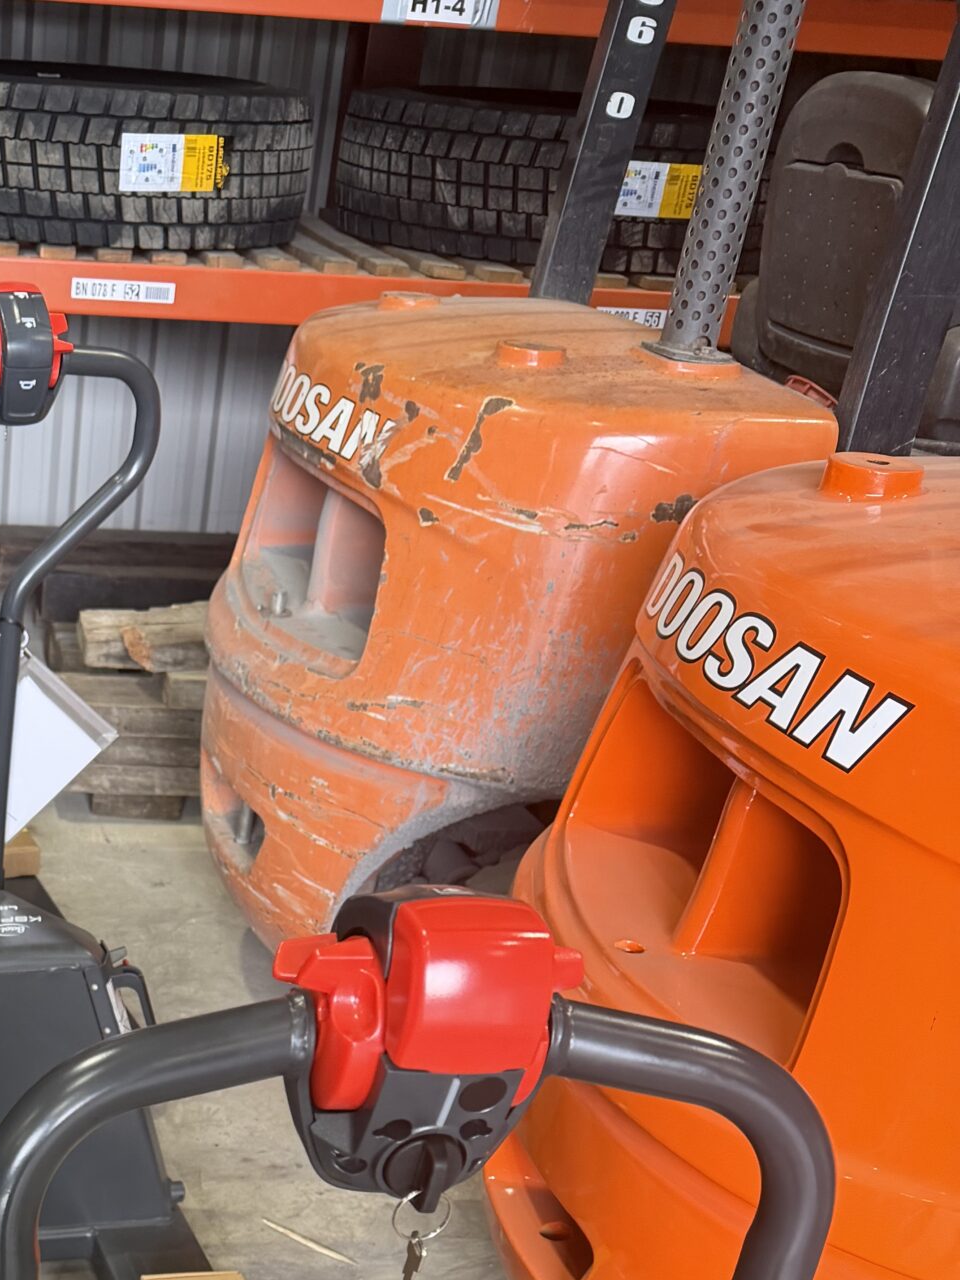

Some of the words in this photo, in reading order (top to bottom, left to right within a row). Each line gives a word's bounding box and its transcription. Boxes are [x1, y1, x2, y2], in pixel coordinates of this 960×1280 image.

[686, 174, 700, 210] BD175
[644, 312, 662, 330] 56
[645, 550, 917, 774] DOOSAN
